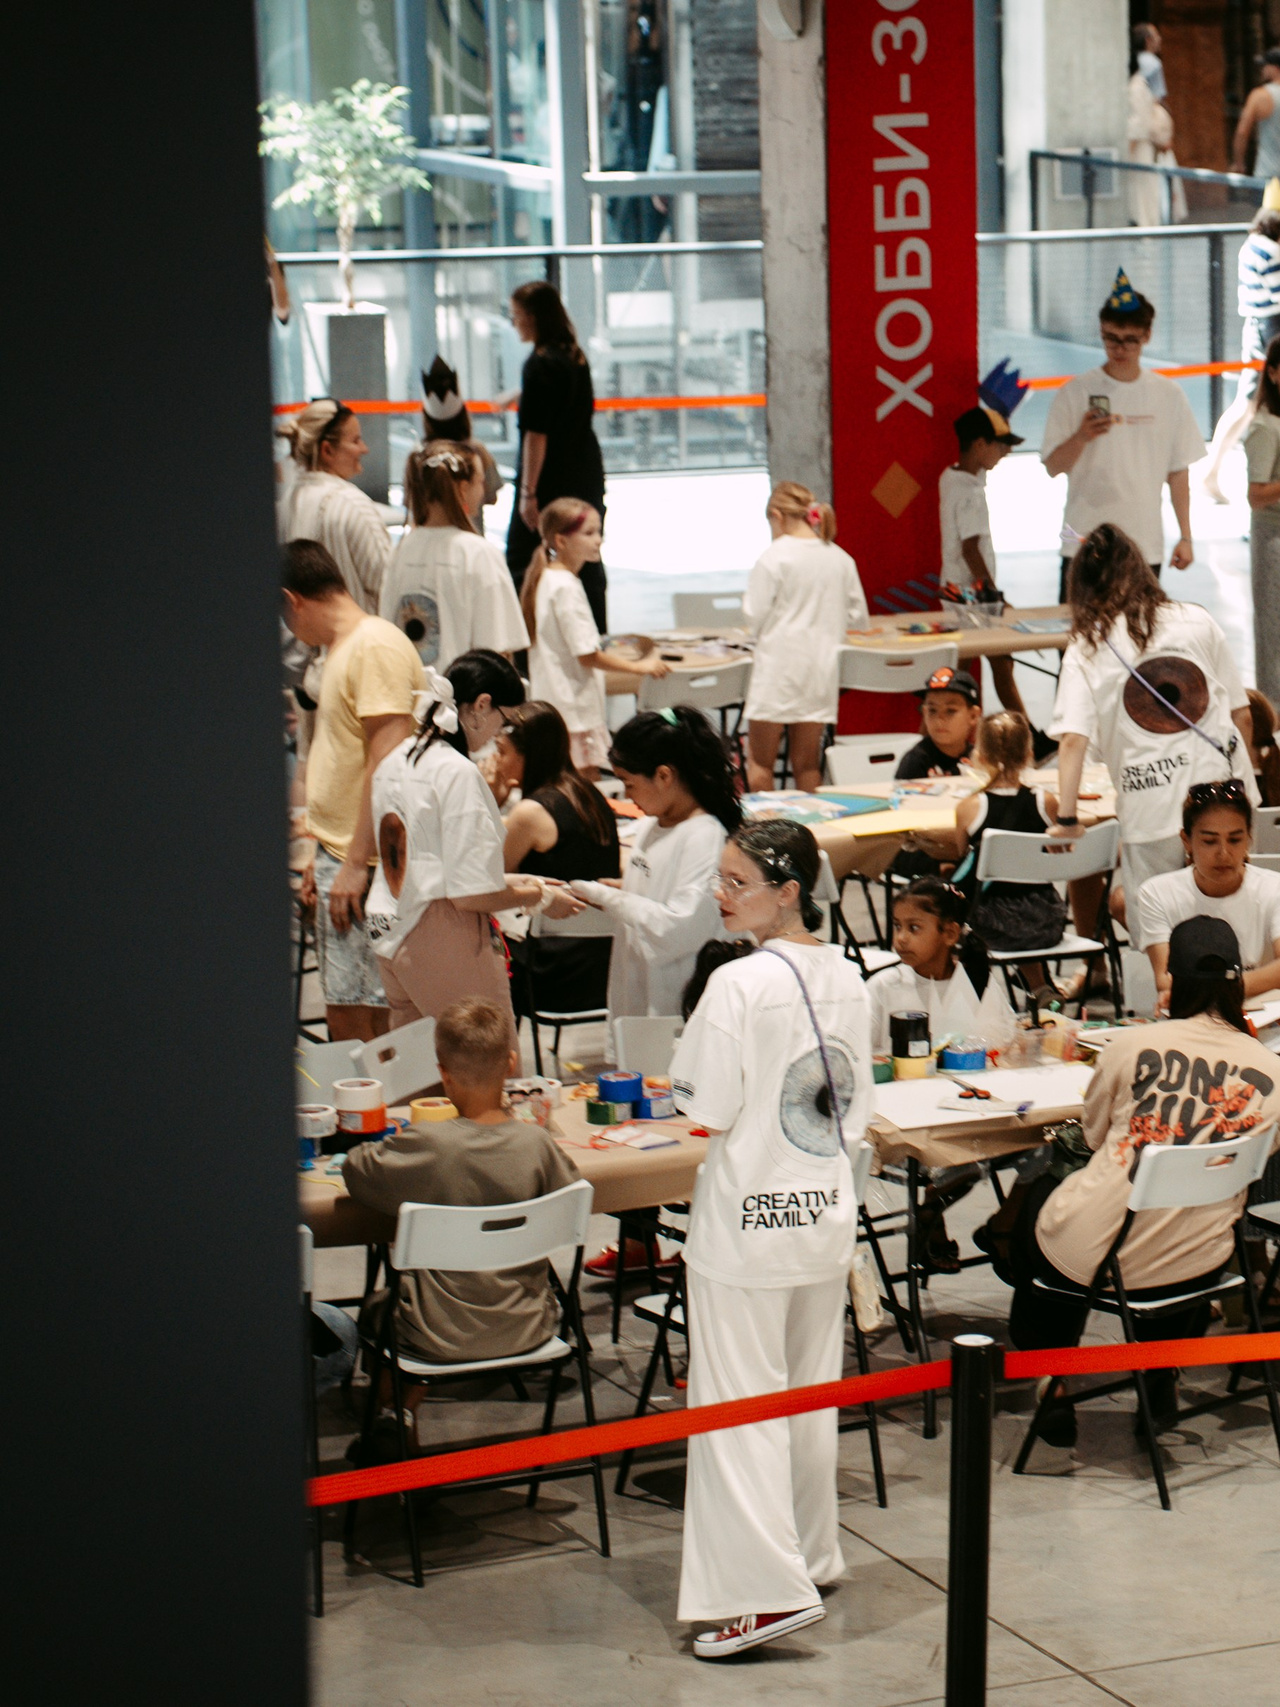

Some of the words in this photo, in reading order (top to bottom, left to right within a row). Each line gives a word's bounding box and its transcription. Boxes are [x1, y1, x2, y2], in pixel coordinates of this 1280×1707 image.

[871, 0, 934, 422] ХОББИ-З
[1121, 773, 1174, 793] FAMILY
[741, 1209, 824, 1231] FAMILY
